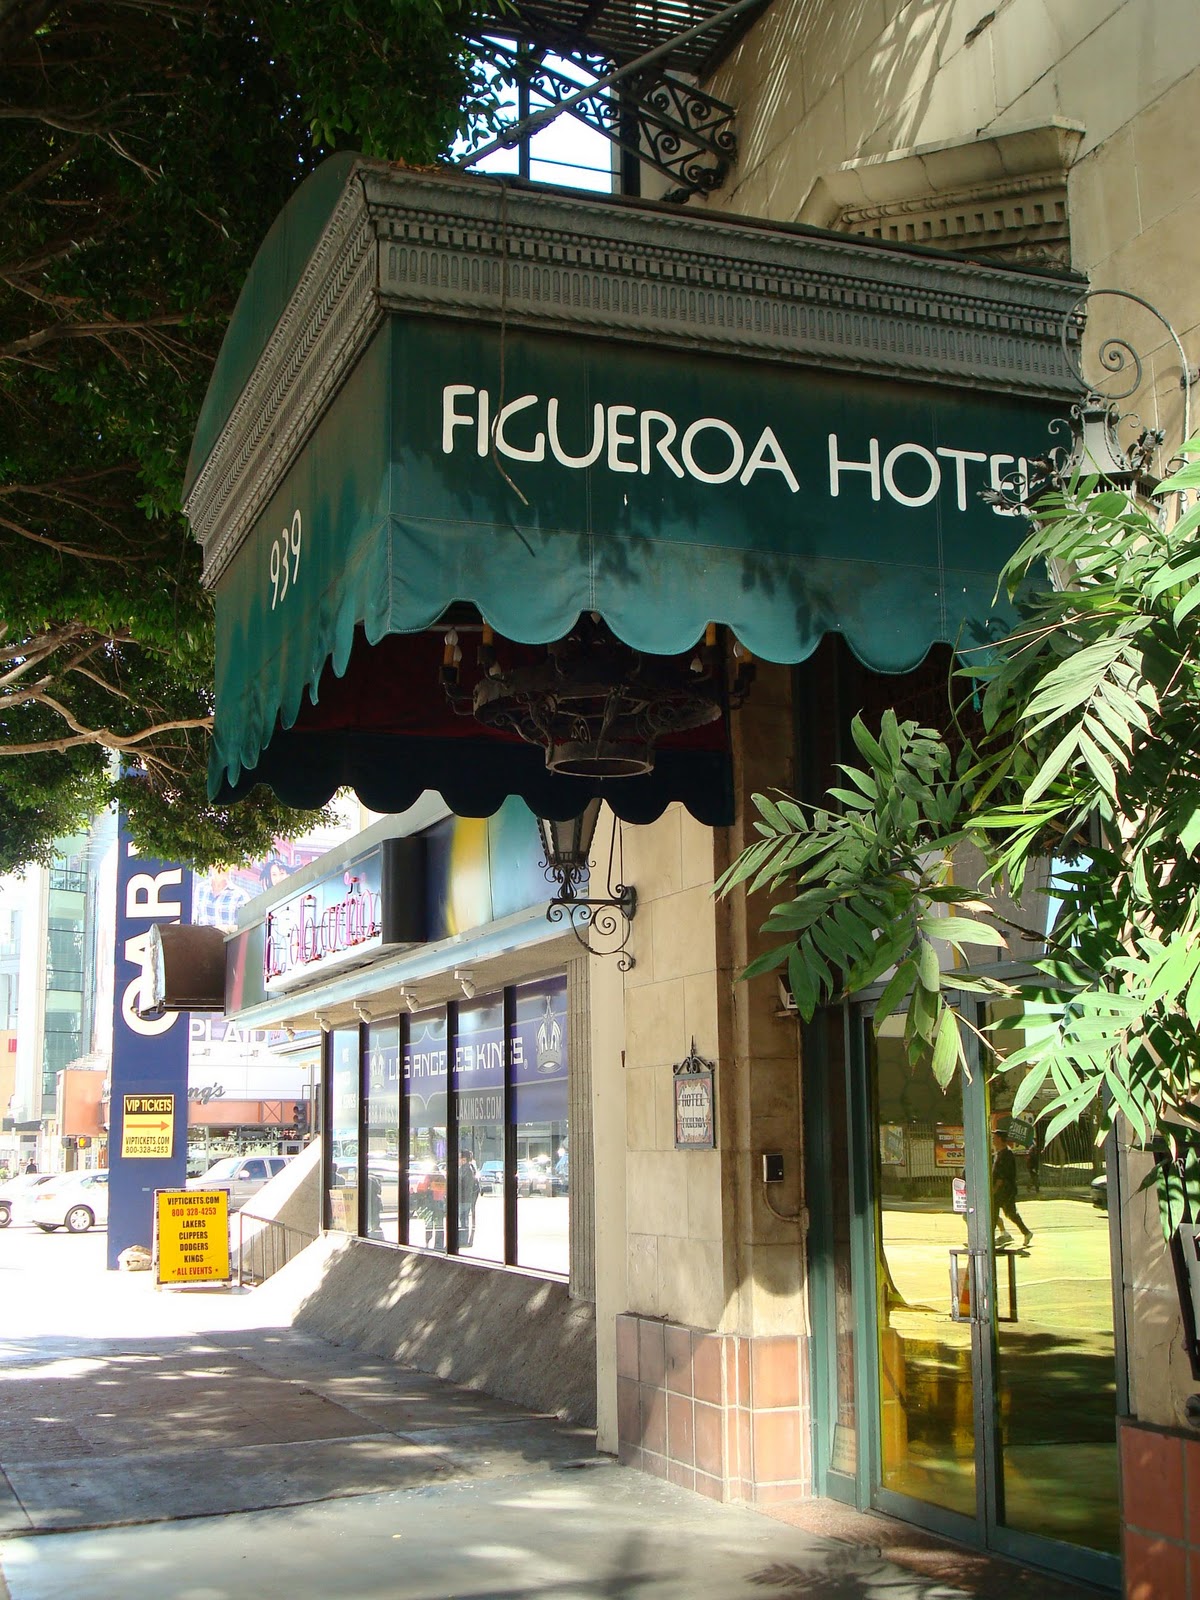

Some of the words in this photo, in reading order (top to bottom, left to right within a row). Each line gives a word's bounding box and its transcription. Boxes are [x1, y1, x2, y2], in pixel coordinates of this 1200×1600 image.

[442, 384, 800, 494] FIGUEROA
[270, 509, 302, 611] 939
[126, 1099, 140, 1112] VIP
[141, 1099, 172, 1112] TICKETS
[682, 1094, 705, 1107] HOTEL
[125, 1136, 170, 1145] VIPTICKETS.COM
[125, 1146, 169, 1154] 800-328-4253
[168, 1196, 220, 1206] VIPTICKETS.COM
[171, 1208, 184, 1217] 800
[186, 1207, 217, 1216] 328-4253
[182, 1219, 206, 1228] LAKERS
[178, 1231, 208, 1240] CLIPPERS
[179, 1242, 209, 1252] DODGERS
[184, 1254, 204, 1263] KINGS
[177, 1267, 187, 1276] ALL
[189, 1266, 213, 1275] EVENTS
